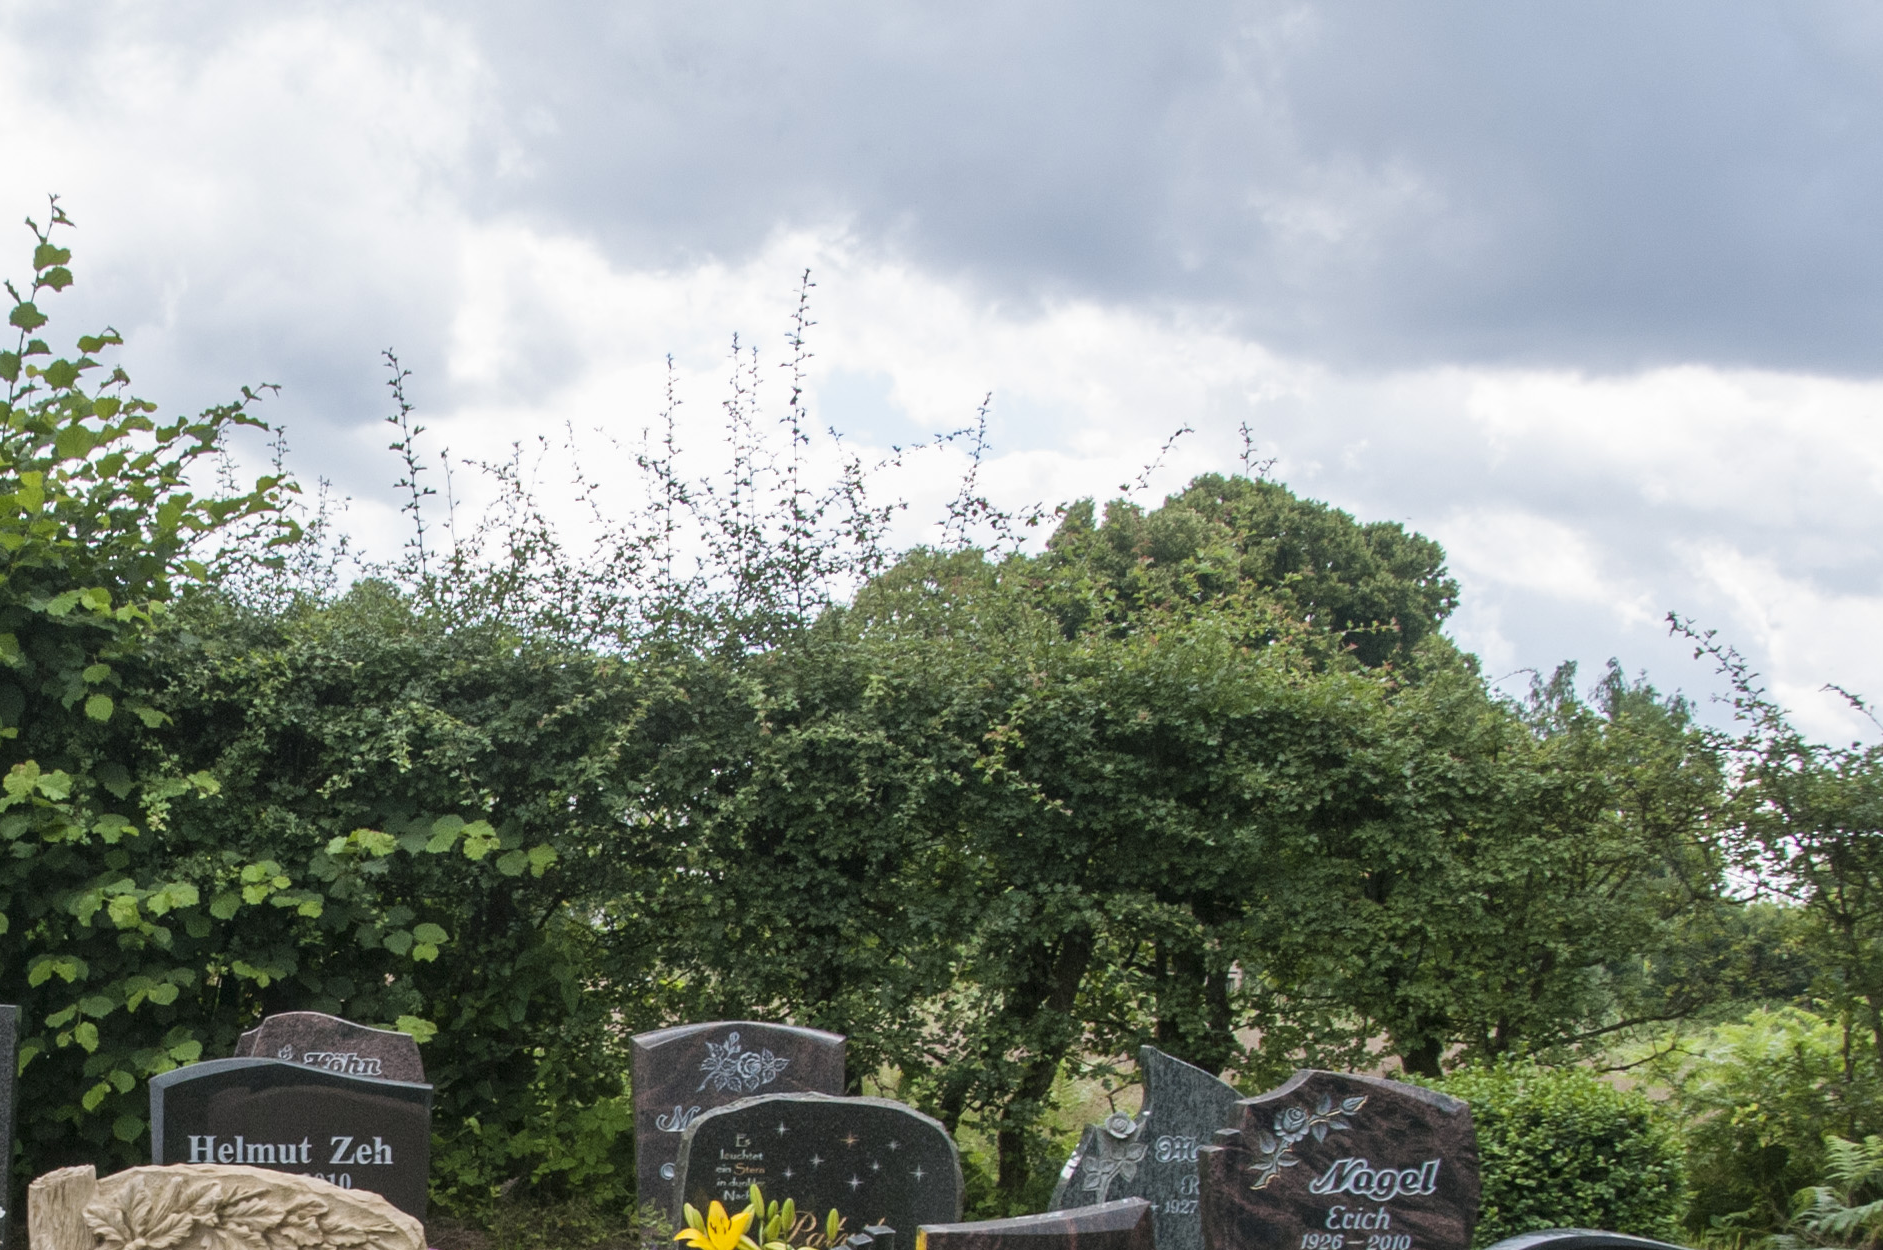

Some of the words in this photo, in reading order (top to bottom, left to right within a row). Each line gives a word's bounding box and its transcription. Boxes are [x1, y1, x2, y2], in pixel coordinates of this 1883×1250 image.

[187, 1135, 313, 1164] Helmut
[329, 1135, 395, 1165] Zeh
[1309, 1156, 1441, 1202] Nagel
[1325, 1205, 1391, 1230] Erich
[1300, 1233, 1345, 1250] 1926
[1366, 1234, 1412, 1250] 2010
